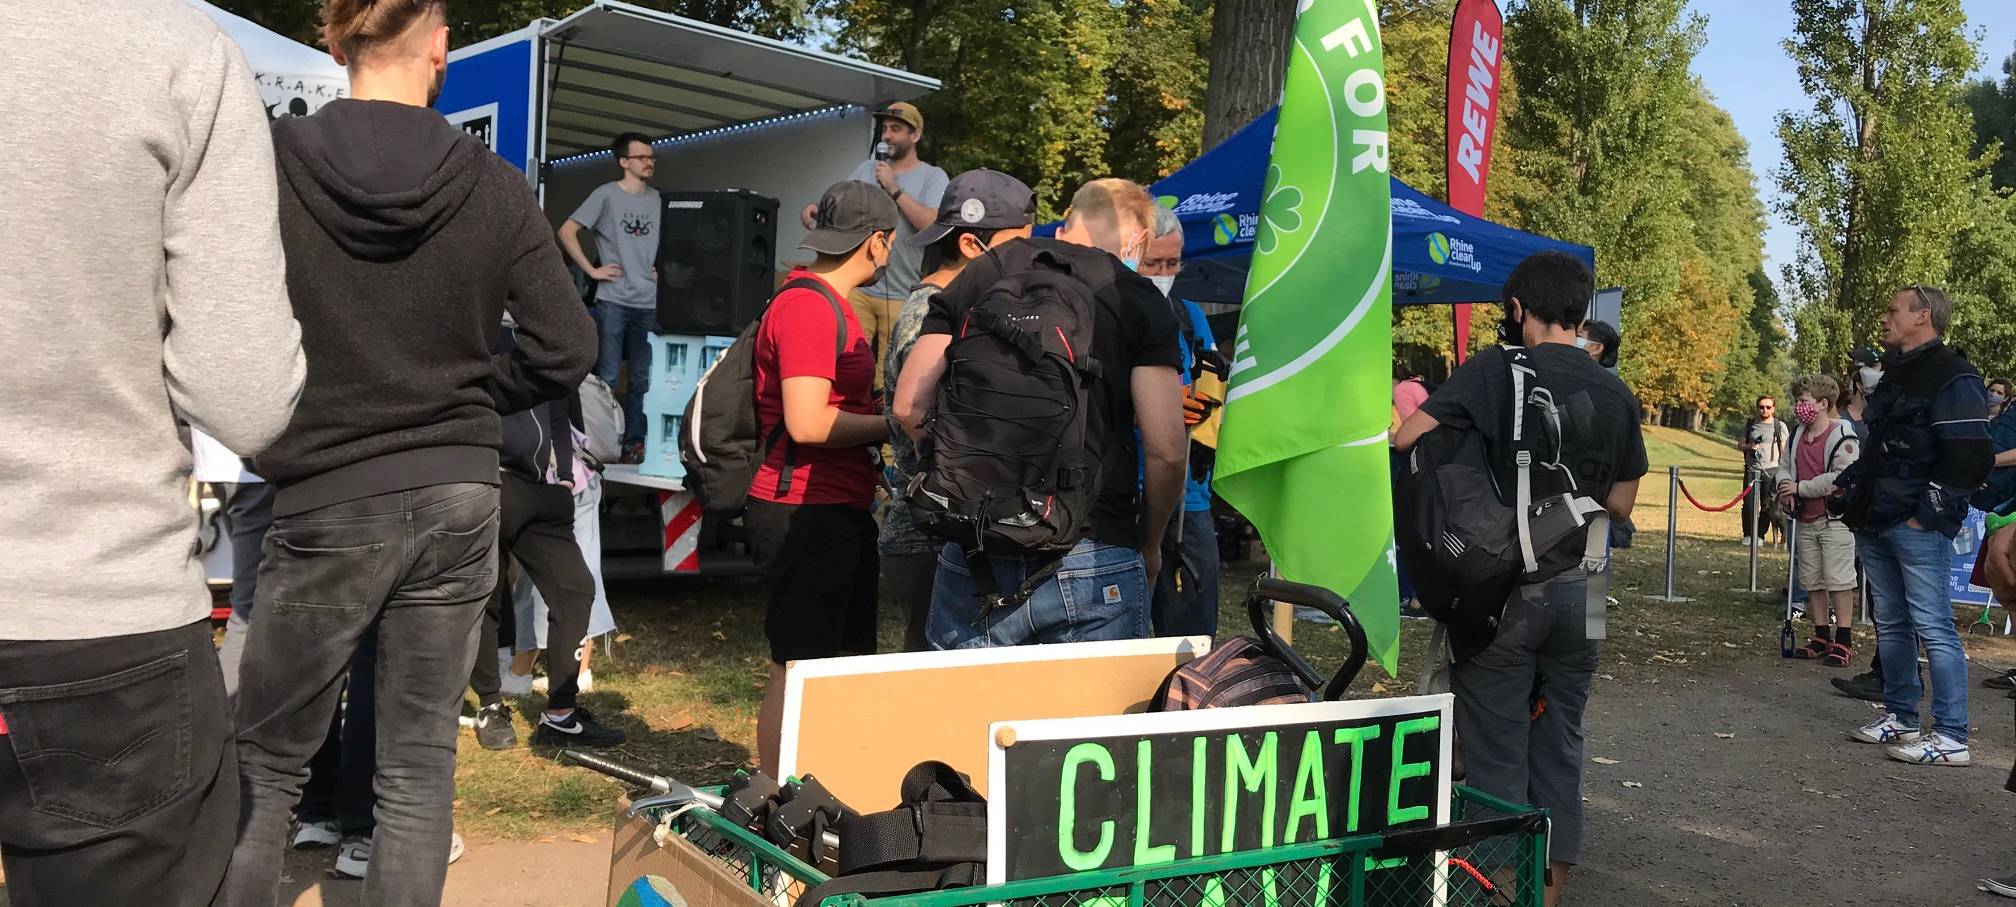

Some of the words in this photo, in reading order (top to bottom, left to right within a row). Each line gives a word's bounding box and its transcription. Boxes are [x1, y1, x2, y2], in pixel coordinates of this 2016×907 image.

[1320, 17, 1389, 175] FOR
[1457, 20, 1499, 184] REWE
[1449, 237, 1474, 253] Rhine
[1058, 715, 1440, 870] CLIMATE
